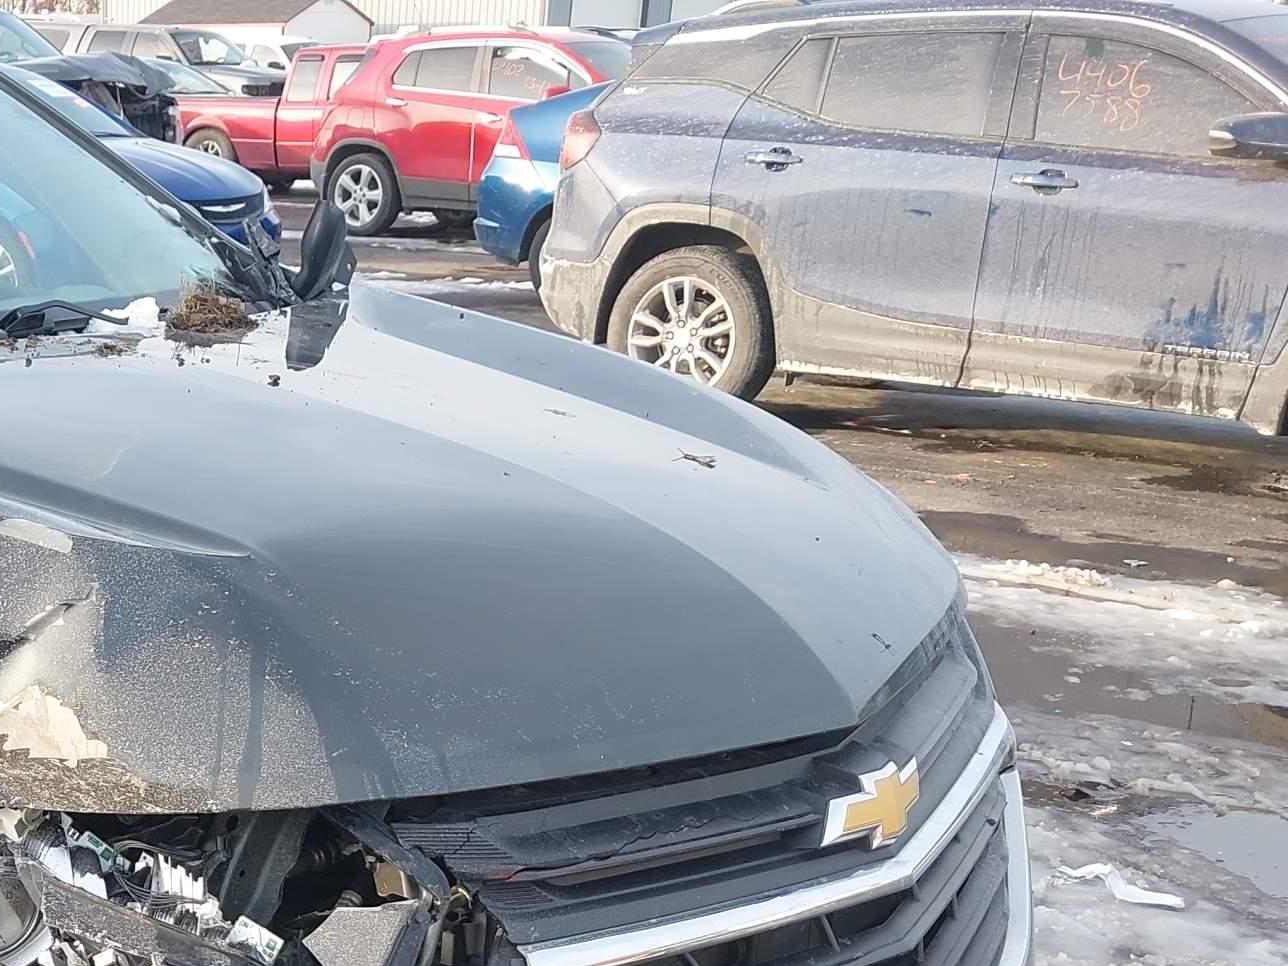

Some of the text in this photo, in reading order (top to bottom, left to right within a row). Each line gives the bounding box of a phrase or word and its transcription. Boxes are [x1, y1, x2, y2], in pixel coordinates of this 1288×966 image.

[1058, 52, 1152, 98] 4406
[1059, 88, 1143, 132] 7588
[1164, 344, 1251, 363] TERRAIN
